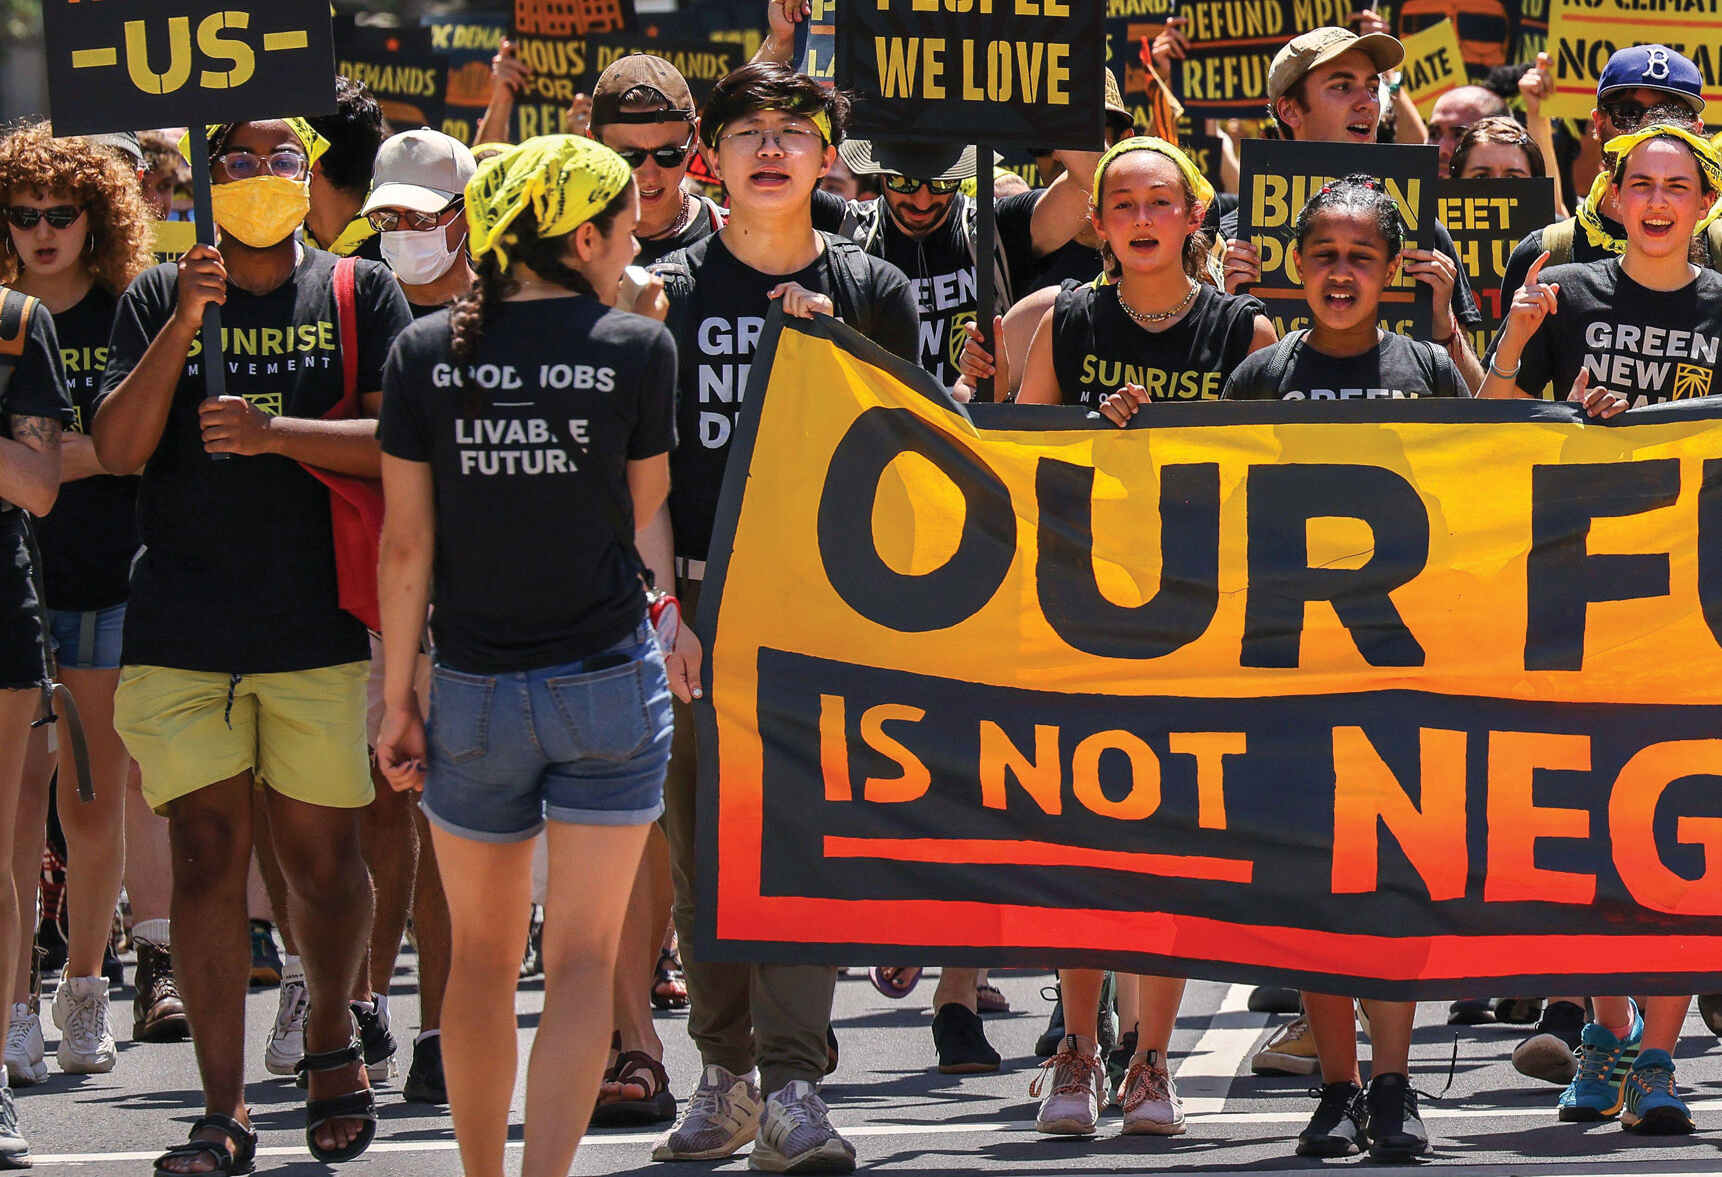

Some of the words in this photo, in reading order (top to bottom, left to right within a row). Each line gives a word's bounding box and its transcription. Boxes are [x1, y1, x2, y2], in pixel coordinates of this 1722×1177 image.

[516, 39, 587, 76] HOUS
[875, 36, 946, 100] WE
[962, 40, 1070, 105] LOVE
[1557, 38, 1616, 80] NO
[1642, 48, 1669, 79] B
[1586, 321, 1720, 364] GREEN
[188, 356, 330, 376] MVEMENT
[1080, 354, 1222, 400] SUNRISE
[1583, 353, 1671, 390] NEW
[817, 406, 1430, 668] OUR
[819, 693, 931, 803] IS
[979, 720, 1247, 830] NOT
